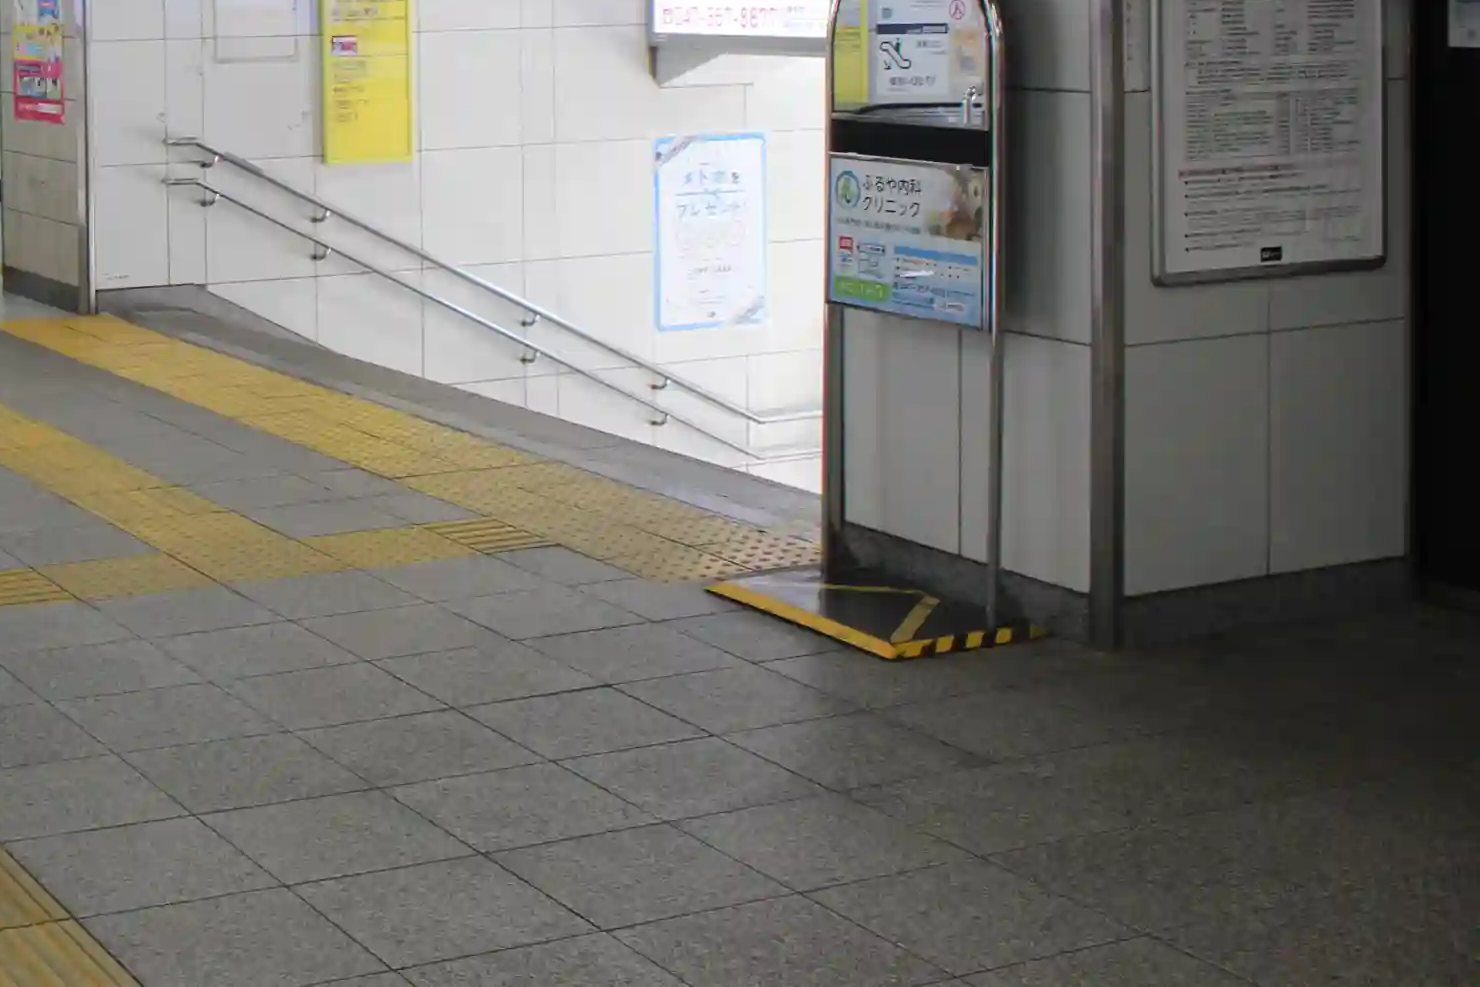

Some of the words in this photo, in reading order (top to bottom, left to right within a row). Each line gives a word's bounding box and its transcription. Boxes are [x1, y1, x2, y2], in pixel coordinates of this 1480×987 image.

[862, 173, 923, 196] ふるや内科
[861, 195, 921, 218] クリニック
